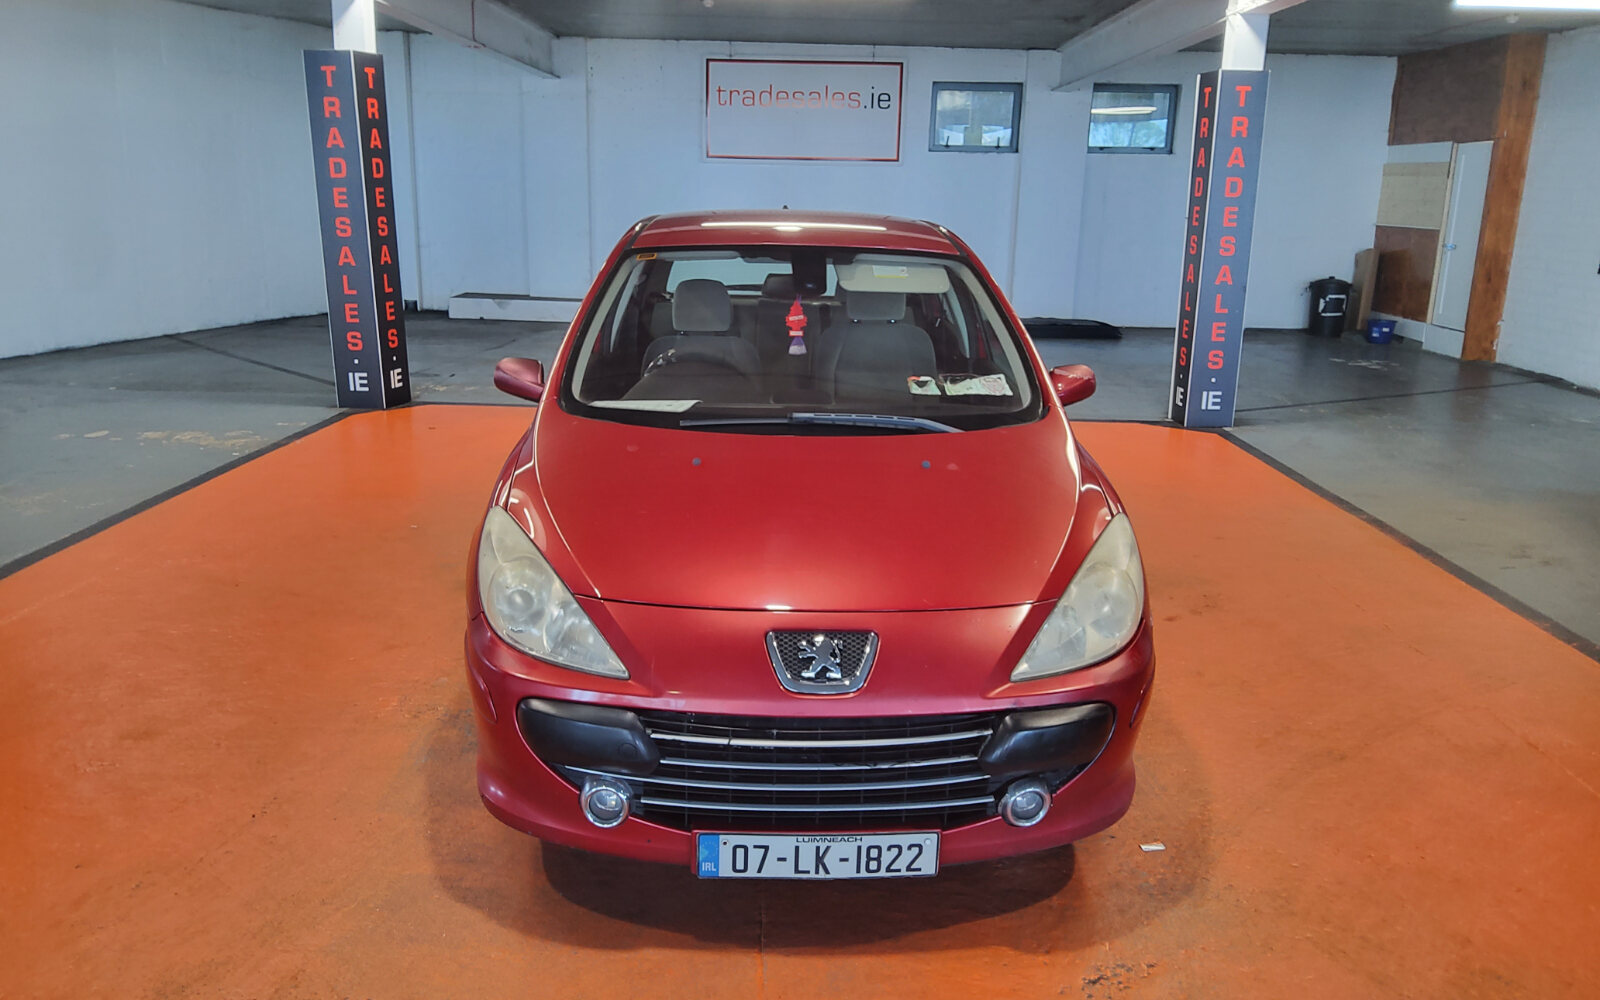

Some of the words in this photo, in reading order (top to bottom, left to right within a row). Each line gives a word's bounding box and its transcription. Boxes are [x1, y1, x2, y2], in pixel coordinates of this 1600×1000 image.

[716, 84, 891, 110] tradesales.ie
[702, 861, 717, 872] IRL
[731, 842, 924, 876] 07-LK-1822
